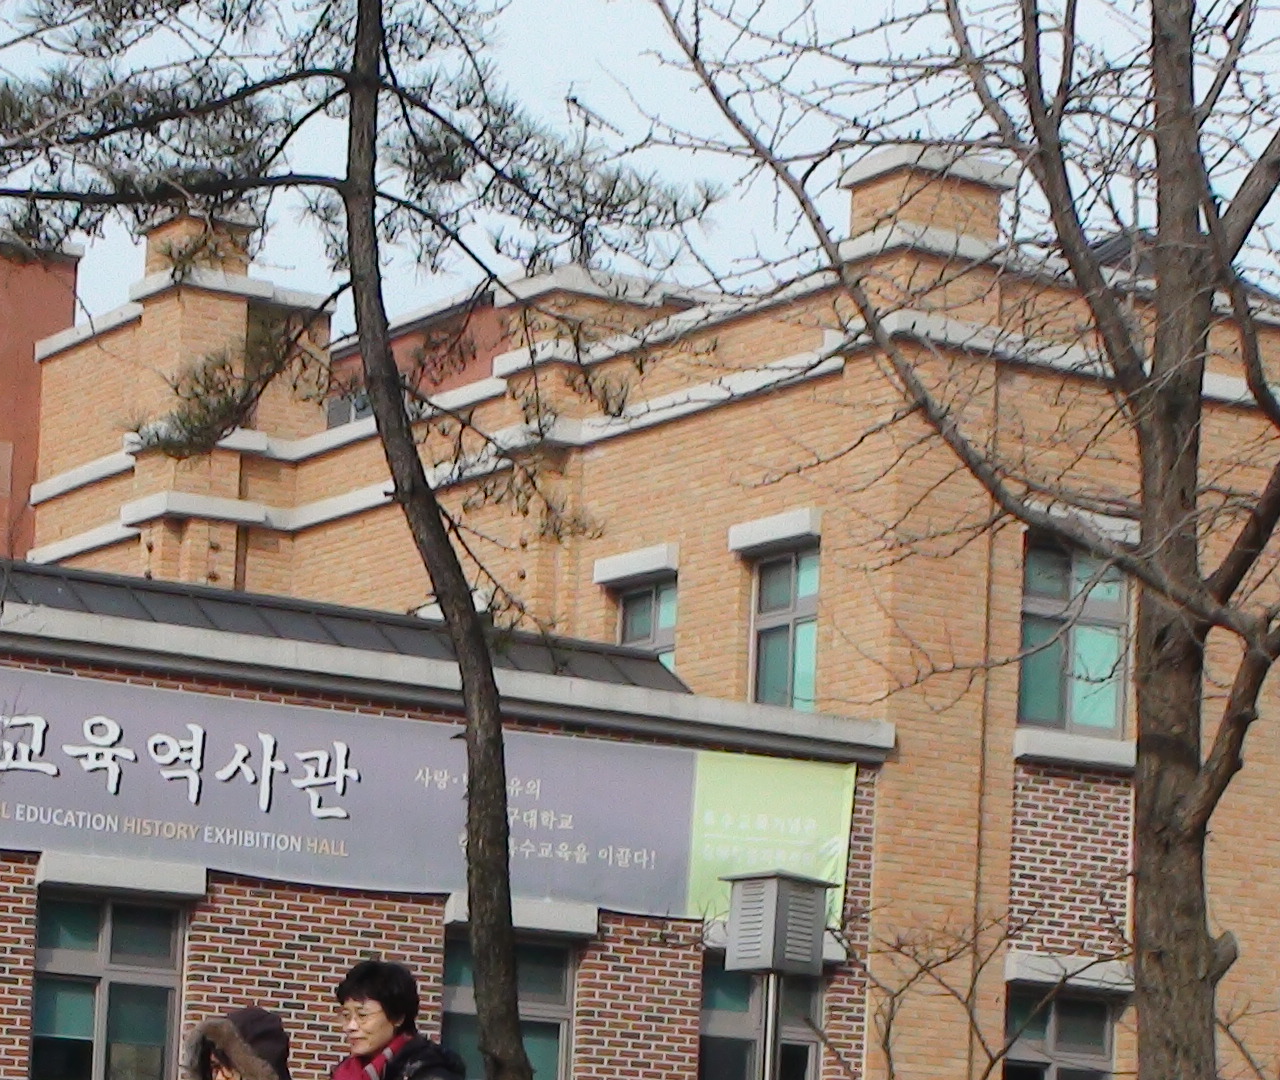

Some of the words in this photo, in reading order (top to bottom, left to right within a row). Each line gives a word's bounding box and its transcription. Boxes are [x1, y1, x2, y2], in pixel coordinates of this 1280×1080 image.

[15, 803, 118, 832] EDUCATION
[123, 817, 199, 841] HISTORY
[202, 825, 302, 852] EXHIBITION
[306, 835, 349, 857] HALL
[506, 807, 574, 830] 구대학교
[598, 845, 656, 870] 이끌다!
